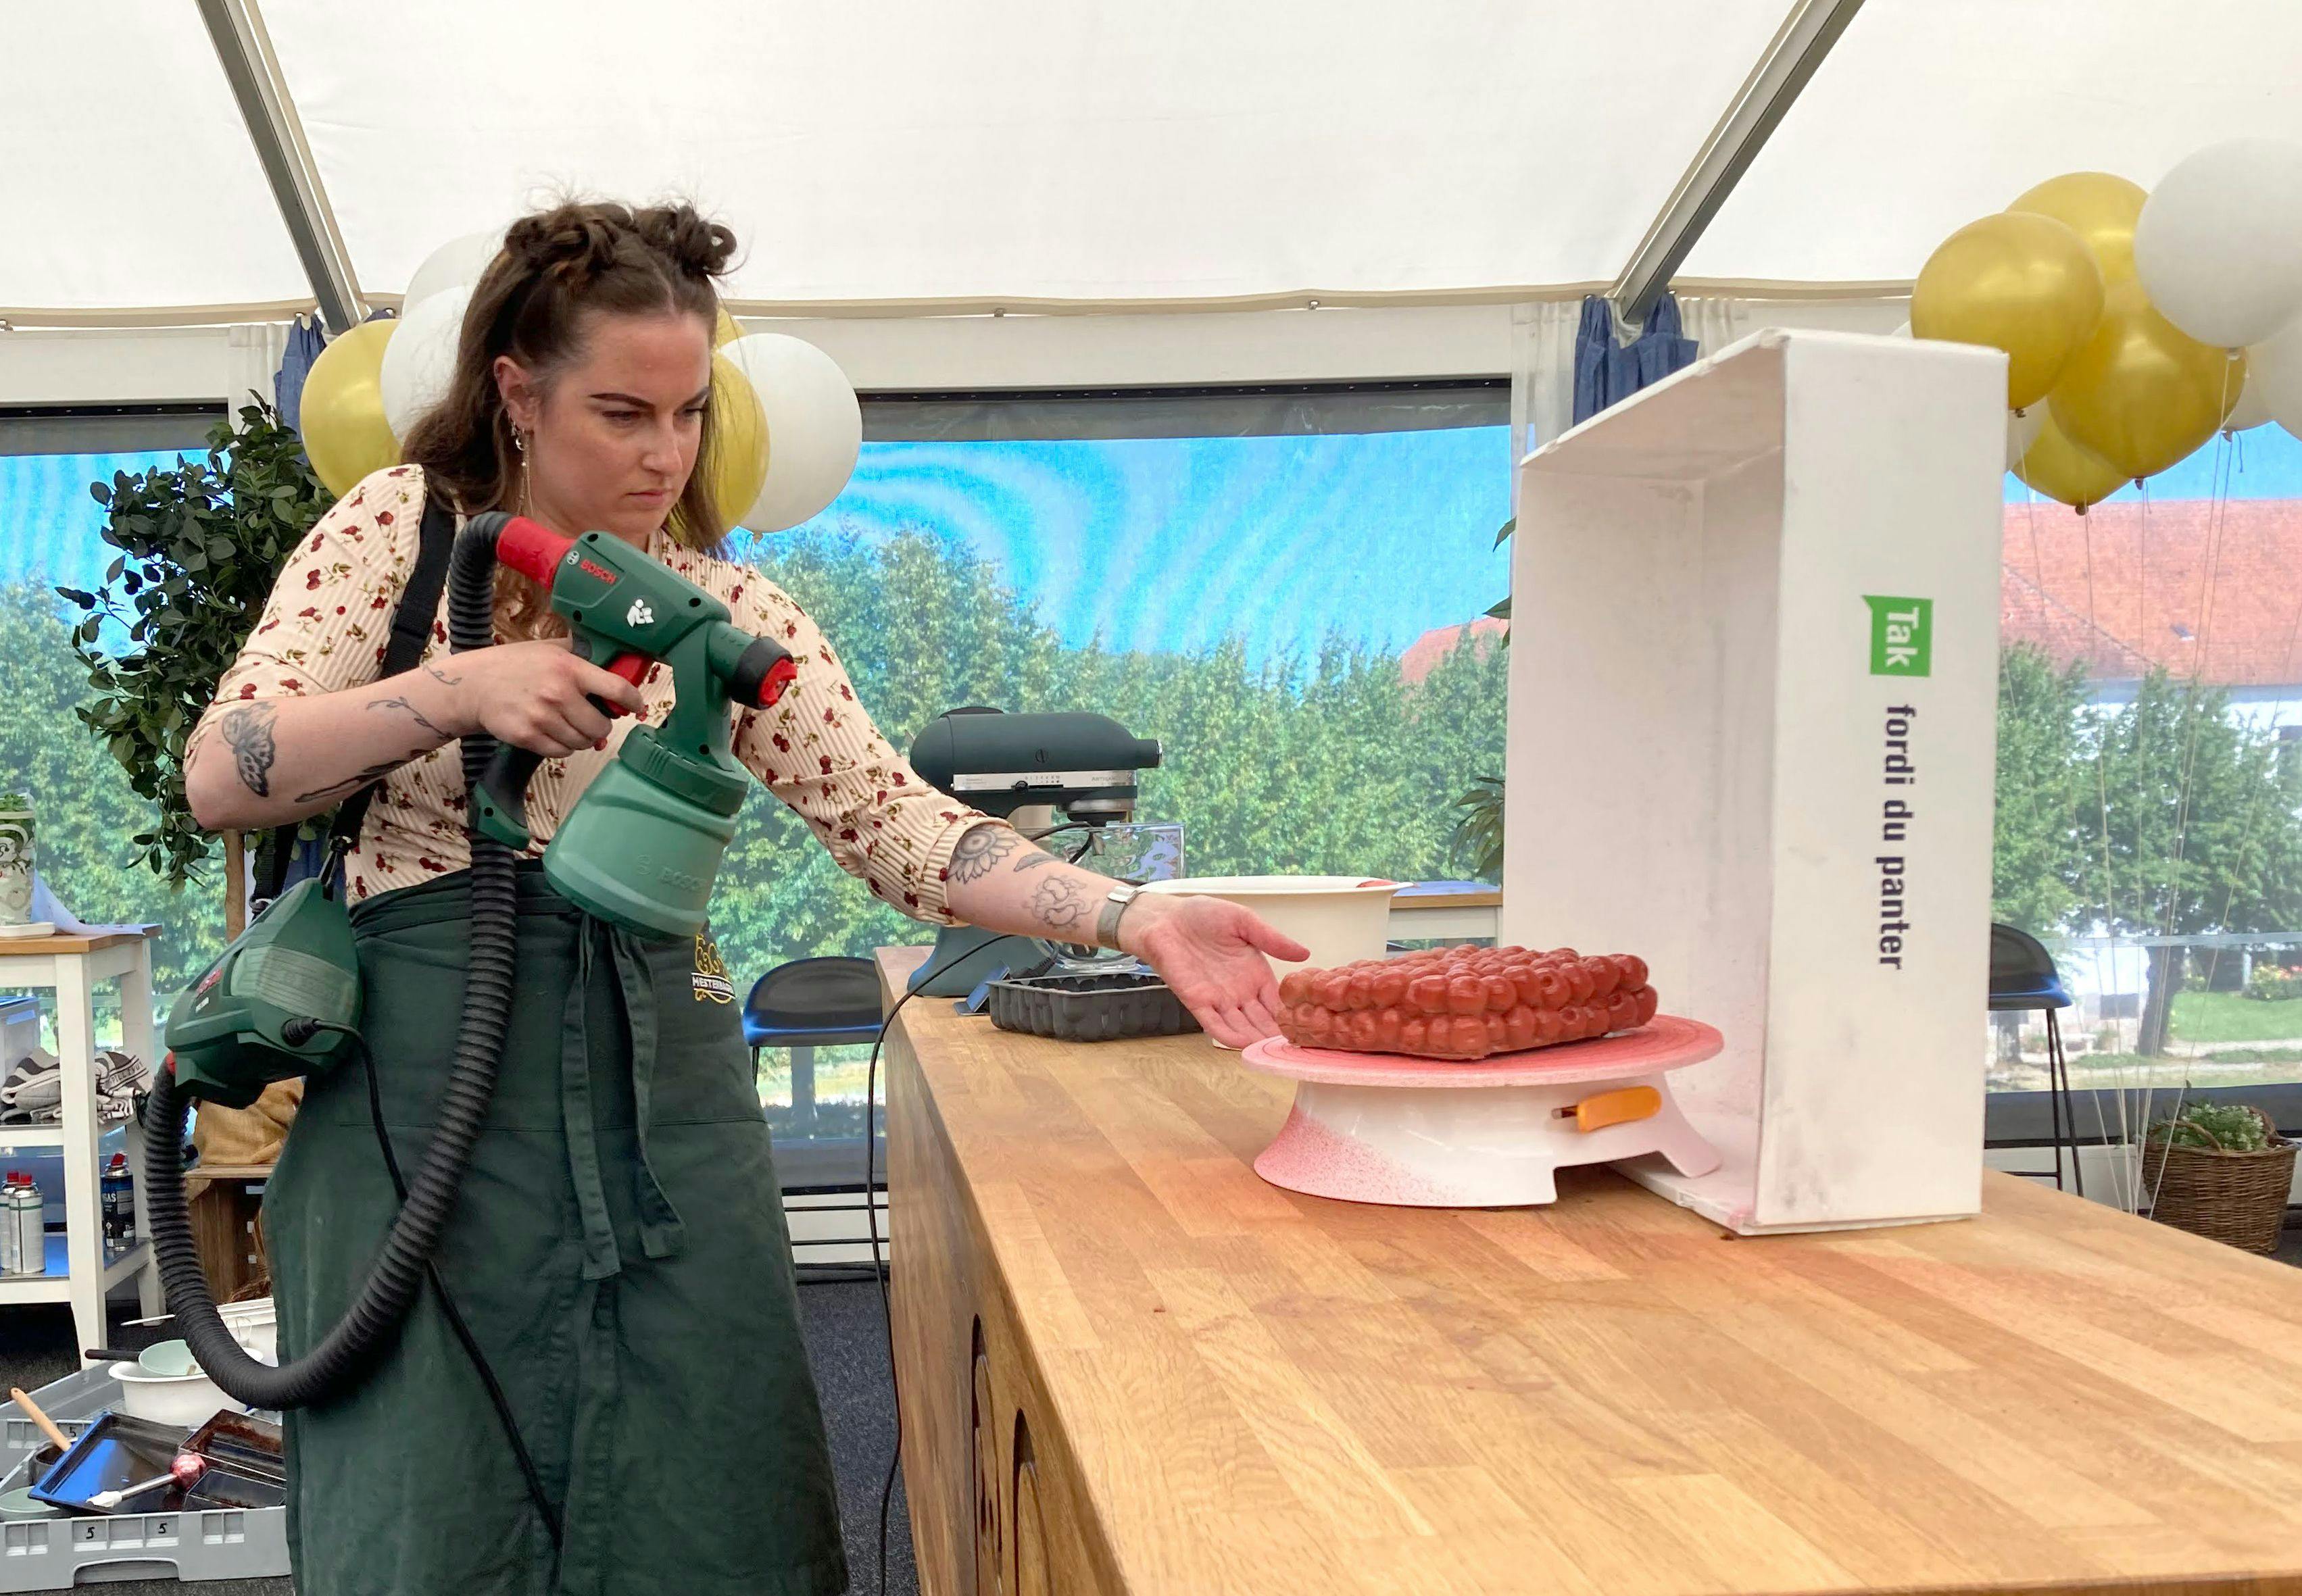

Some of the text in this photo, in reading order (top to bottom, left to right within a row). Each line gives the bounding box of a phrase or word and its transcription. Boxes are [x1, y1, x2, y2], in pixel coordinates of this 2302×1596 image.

[581, 559, 616, 584] BOSCH
[1876, 607, 1919, 970] Tak fordi du panter
[69, 1426, 76, 1437] 5
[86, 1523, 167, 1539] 5 5
